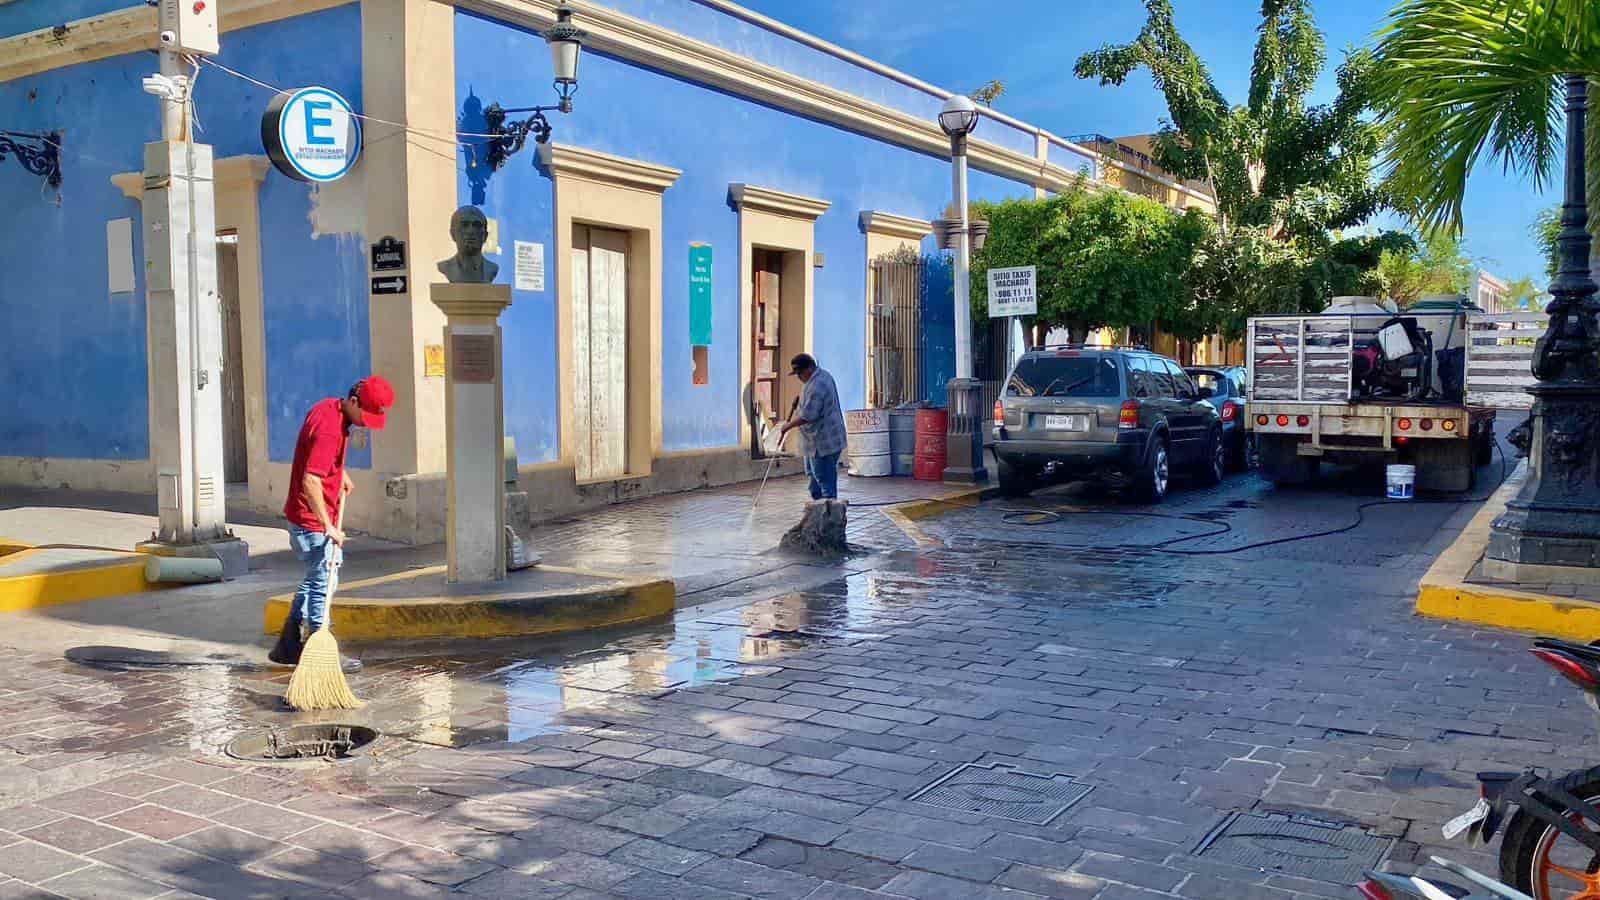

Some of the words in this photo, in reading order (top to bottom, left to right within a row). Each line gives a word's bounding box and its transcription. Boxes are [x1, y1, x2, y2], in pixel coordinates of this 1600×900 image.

[303, 100, 336, 145] E
[993, 272, 1010, 280] SITIO
[996, 279, 1028, 287] MACHADO
